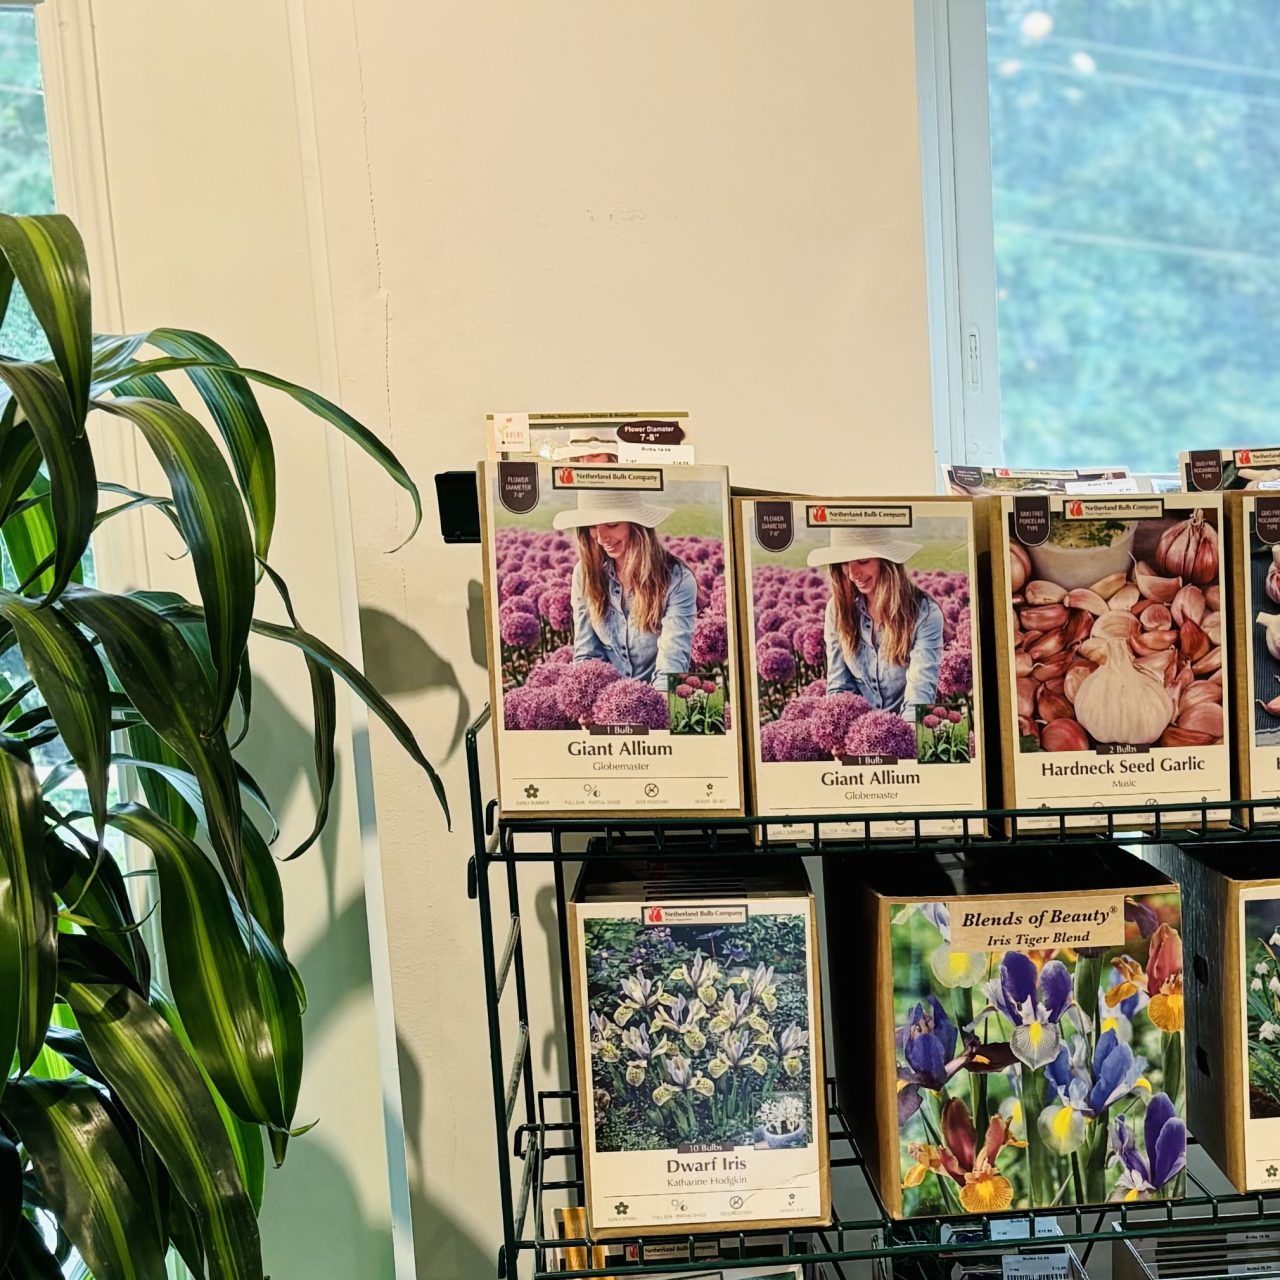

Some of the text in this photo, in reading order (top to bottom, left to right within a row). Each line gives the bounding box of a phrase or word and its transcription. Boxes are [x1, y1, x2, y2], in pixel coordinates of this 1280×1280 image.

[576, 473, 611, 481] Netherland
[628, 474, 657, 482] Company
[607, 726, 633, 734] 1 Bulb
[568, 741, 673, 756] Giant Allium
[865, 756, 883, 764] Bulb
[593, 762, 650, 771] Globemaster
[1042, 756, 1205, 776] Hardneck Seed Garlic
[821, 771, 920, 786] Giant Allium
[1112, 779, 1136, 788] Music
[845, 791, 898, 800] Globemaster
[962, 912, 1023, 928] Blends
[1029, 910, 1049, 928] of
[987, 931, 1090, 946] Iris Tiger Blend
[690, 1144, 723, 1152] 10 Bulbs
[667, 1156, 747, 1173] Dwarf Iris
[667, 1176, 747, 1187] Katharine Hodgkin
